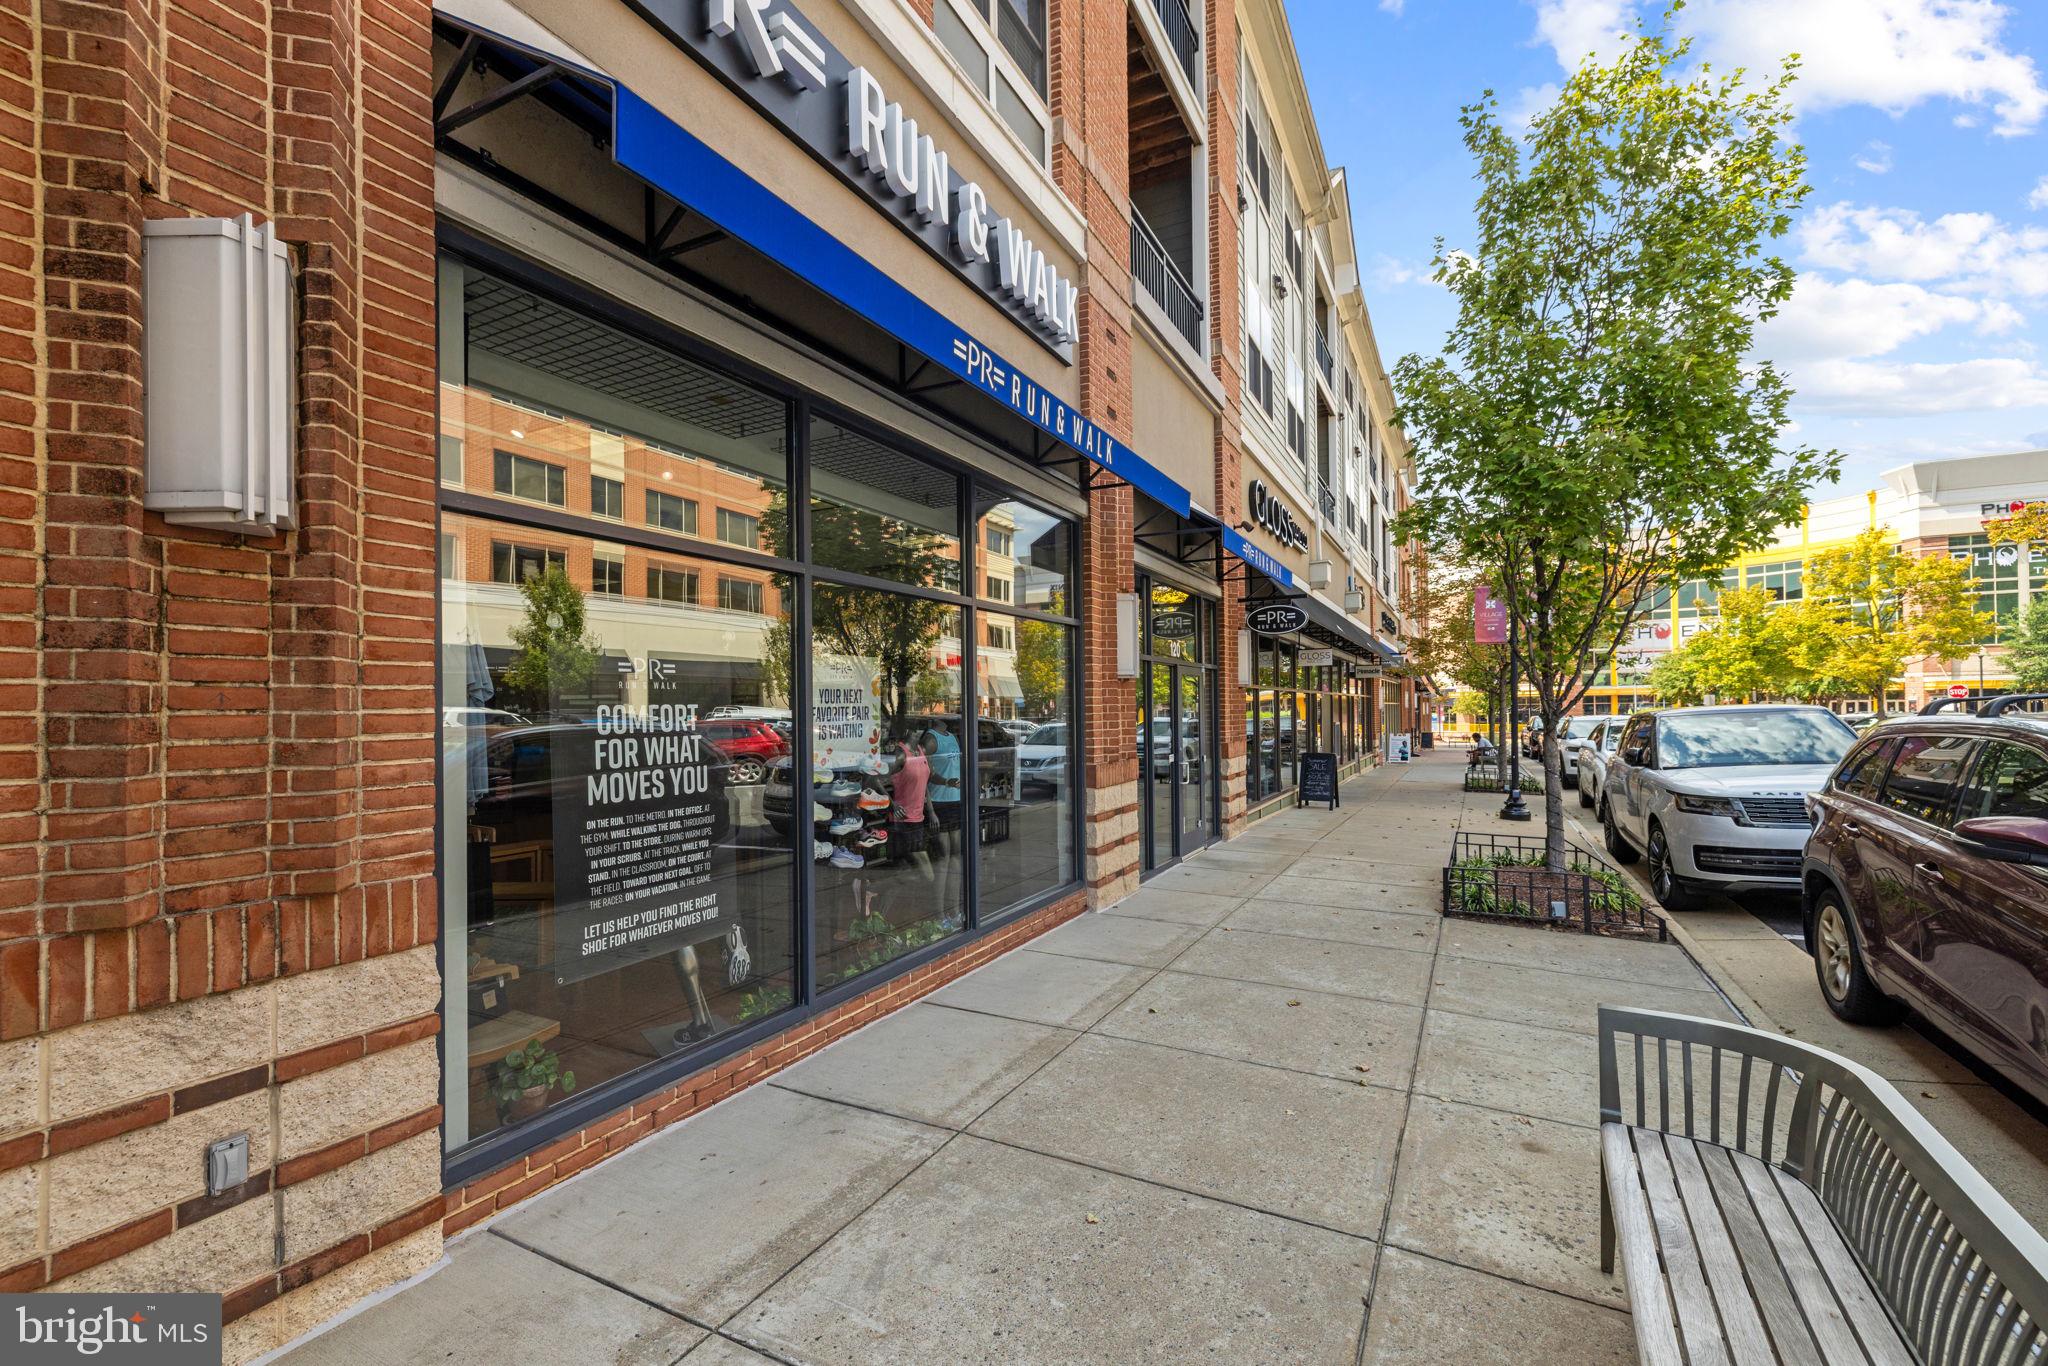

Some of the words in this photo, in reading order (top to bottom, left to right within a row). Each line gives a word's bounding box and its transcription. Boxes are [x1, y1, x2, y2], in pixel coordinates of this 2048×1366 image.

[848, 66, 948, 225] RUN
[958, 182, 989, 264] &
[997, 217, 1080, 344] WALK
[1012, 374, 1050, 426] RUN
[1056, 405, 1065, 435] &
[1073, 415, 1113, 465] WALK
[1249, 479, 1294, 548] GLOSS
[1300, 652, 1331, 660] GLOSS
[654, 681, 677, 690] WALK
[819, 689, 841, 704] YOUR
[843, 688, 863, 704] NEXT
[596, 704, 698, 736] COMFORT
[812, 706, 850, 722] FAVORITE
[852, 706, 870, 720] PAIR
[818, 725, 827, 740] IS
[828, 723, 863, 740] WAITING
[594, 738, 639, 770] FOR
[643, 734, 702, 766] WHAT
[587, 768, 665, 806] MOVES
[670, 765, 708, 796] YOU
[580, 834, 592, 844] THE
[610, 828, 630, 839] WHILE
[631, 824, 658, 836] WALKING
[658, 822, 668, 831] THE
[682, 815, 715, 827] THROUGHOUT
[586, 820, 596, 830] ON
[597, 818, 610, 828] THE
[626, 815, 634, 824] TO
[634, 813, 646, 822] THE
[668, 810, 674, 818] IN
[675, 808, 685, 816] THE
[704, 804, 710, 812] AT
[585, 846, 602, 857] YOUR
[622, 842, 630, 850] TO
[631, 839, 642, 848] THE
[664, 832, 684, 843] DURING
[685, 829, 700, 839] WARM
[591, 860, 598, 870] IN
[599, 857, 616, 868] YOUR
[644, 850, 650, 859] AT
[652, 848, 662, 858] THE
[682, 841, 698, 851] WHILE
[698, 840, 710, 848] YOU
[588, 872, 610, 884] STAND.
[612, 870, 618, 878] IN
[619, 866, 630, 877] THE
[668, 858, 676, 866] ON
[677, 856, 687, 864] THE
[706, 850, 712, 858] AT
[590, 886, 602, 896] THE
[622, 876, 648, 889] TOWARD
[648, 872, 664, 884] YOUR
[664, 870, 678, 880] NEXT
[694, 863, 704, 873] OFF
[704, 862, 710, 870] TO
[590, 899, 601, 910] THE
[625, 892, 634, 902] ON
[634, 888, 650, 899] YOUR
[680, 880, 686, 888] IN
[686, 878, 696, 886] THE
[582, 937, 608, 956] SHOE
[610, 932, 627, 948] FOR
[628, 919, 674, 943] WHATEVER
[674, 912, 701, 930] MOVES
[701, 906, 719, 922] YOU!
[584, 924, 600, 940] LET
[602, 920, 614, 934] US
[617, 914, 640, 931] HELP
[640, 908, 658, 924] YOU
[660, 904, 678, 920] FIND
[679, 900, 694, 912] THE
[696, 894, 716, 909] RIGHT
